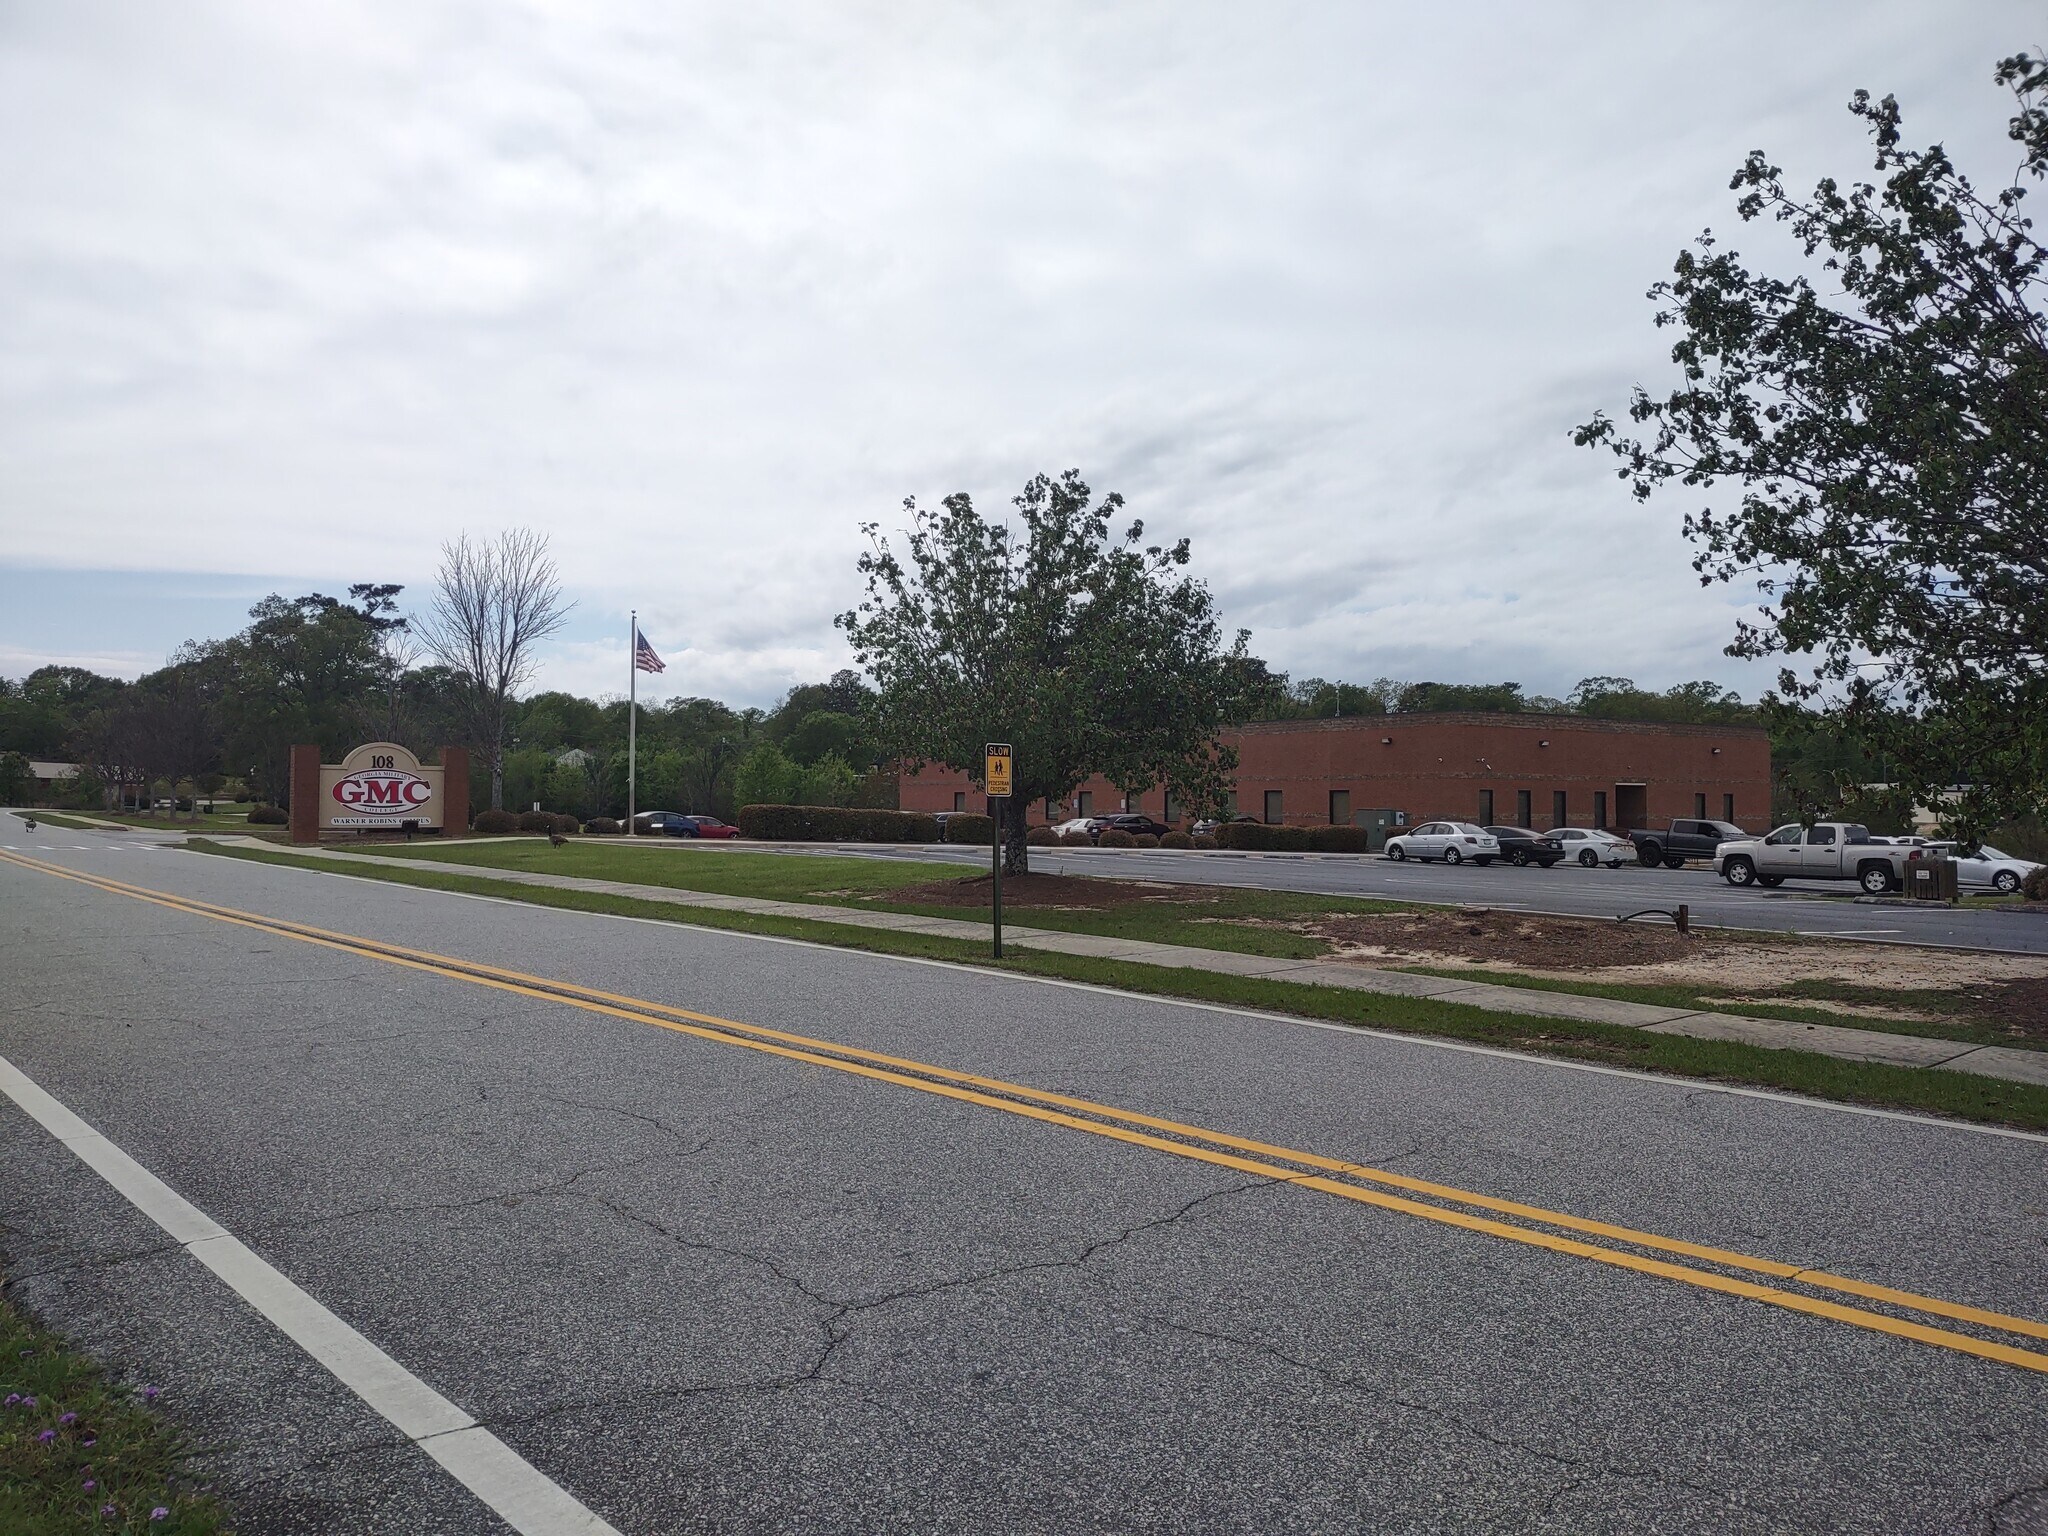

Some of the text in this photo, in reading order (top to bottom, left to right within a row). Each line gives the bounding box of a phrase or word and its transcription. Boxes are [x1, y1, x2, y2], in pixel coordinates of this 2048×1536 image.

[989, 746, 1009, 756] SLOW
[371, 755, 394, 769] 108
[353, 771, 412, 780] GEORGIA MILITARY
[332, 780, 431, 804] GMC
